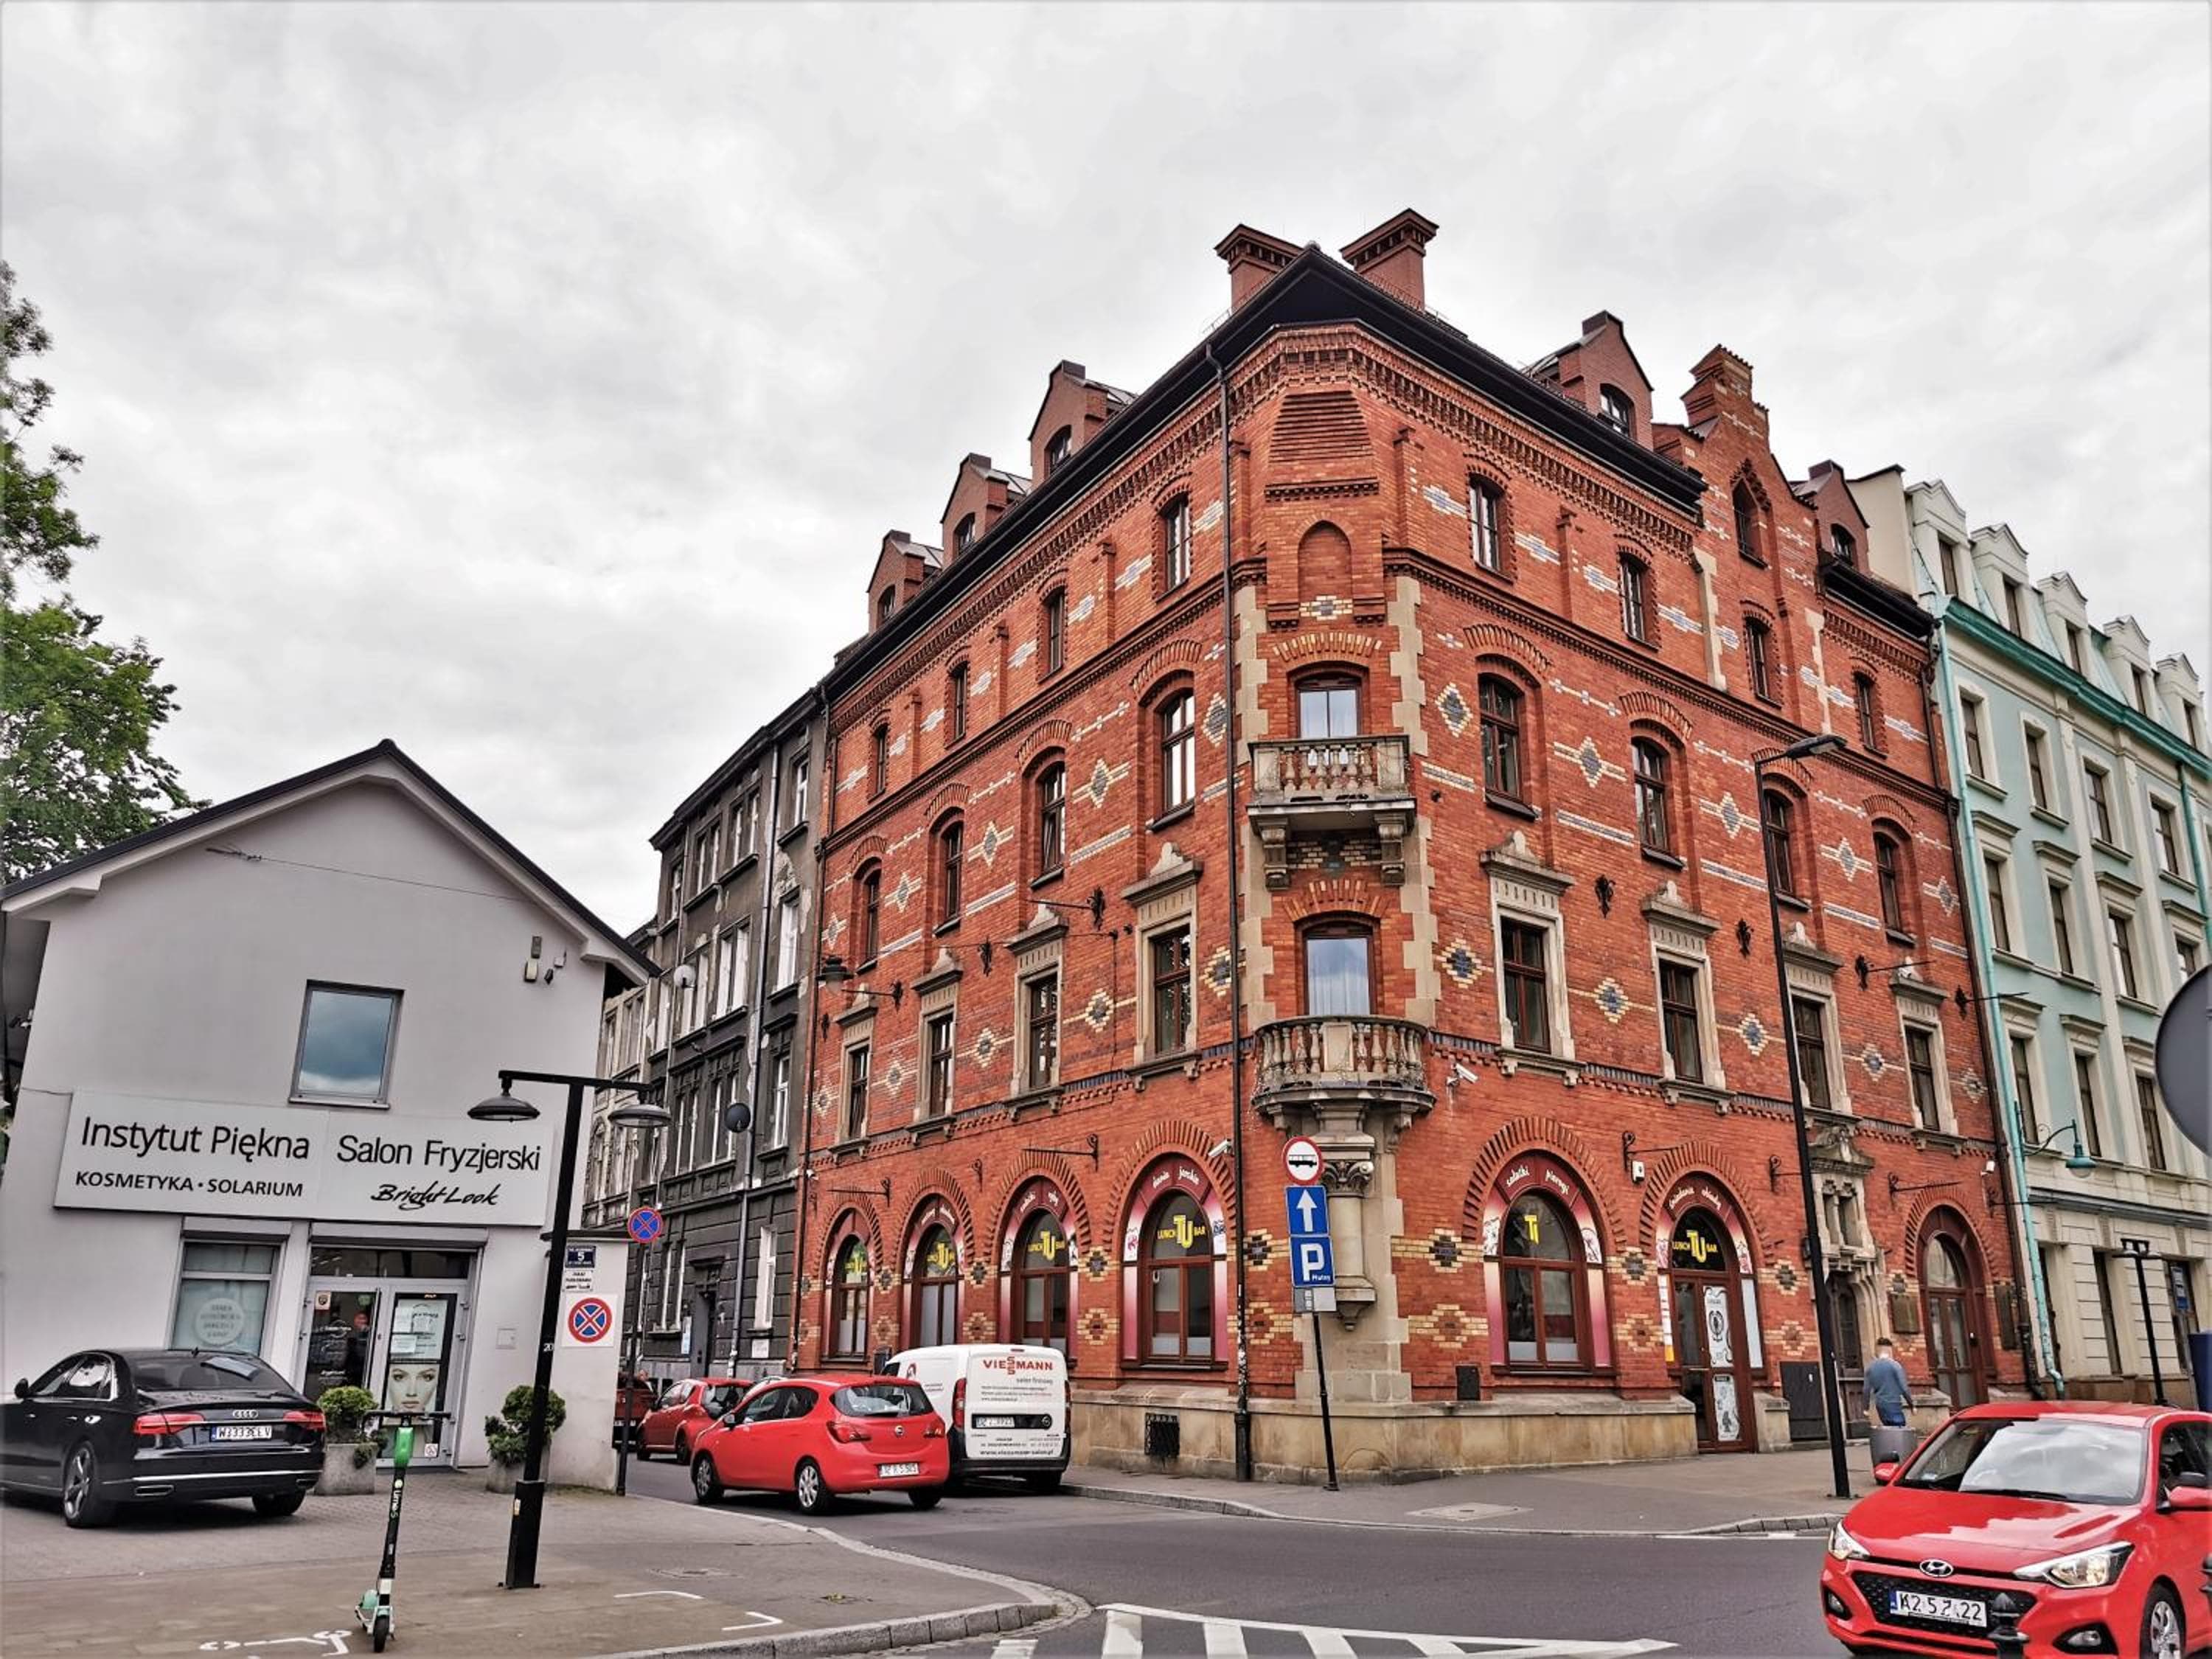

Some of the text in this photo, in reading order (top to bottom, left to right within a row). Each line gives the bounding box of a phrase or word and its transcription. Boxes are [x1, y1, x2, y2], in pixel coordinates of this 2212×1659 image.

[80, 1116, 310, 1163] Instytut Piękna
[336, 1134, 541, 1175] Salon Fryzjerski
[74, 1170, 304, 1197] KOSMETYKA SOLARIUM
[369, 1180, 501, 1211] Bright Look
[1040, 1231, 1057, 1260] TU
[1173, 1214, 1193, 1248] TU
[1686, 1229, 1707, 1263] TU
[577, 1251, 585, 1262] 5
[1300, 1242, 1325, 1281] P
[982, 1356, 1054, 1375] VIESSMANN
